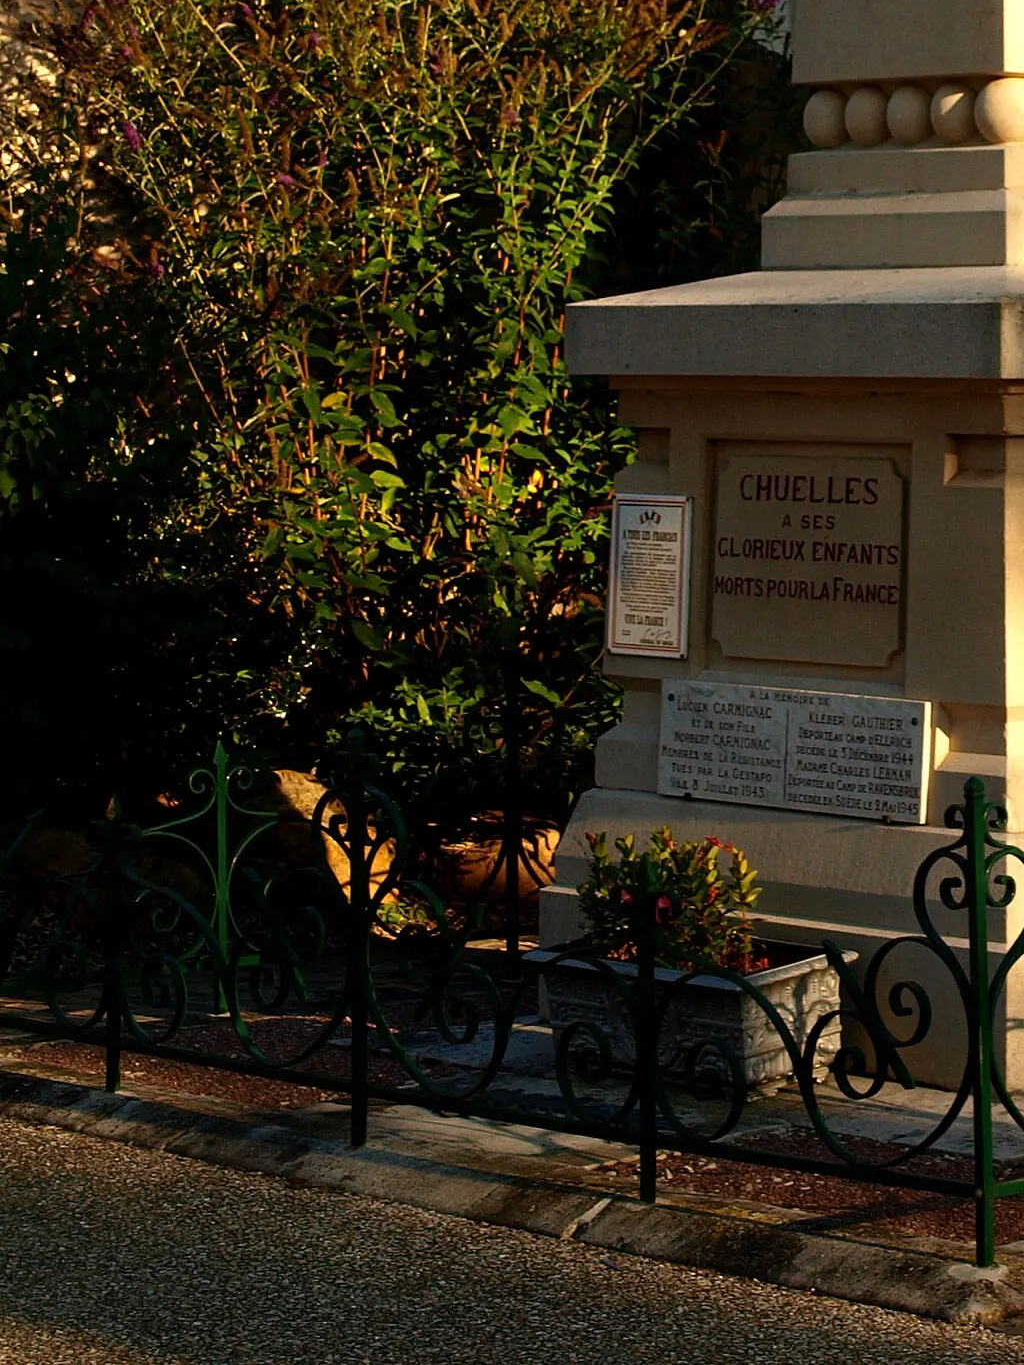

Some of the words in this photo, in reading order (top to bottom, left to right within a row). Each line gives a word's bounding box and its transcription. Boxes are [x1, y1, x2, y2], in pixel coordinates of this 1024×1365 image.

[740, 474, 878, 504] CHUELLES
[781, 514, 792, 528] A
[801, 514, 836, 530] SES
[718, 537, 805, 561] GLORIEUX
[812, 541, 900, 565] ENFANTS
[715, 576, 764, 597] MORTS
[766, 579, 809, 599] POUR
[810, 581, 831, 600] LA
[833, 577, 899, 604] FRANCE
[677, 697, 708, 713] LUCIEN
[713, 702, 772, 719] CARMIGNAC
[852, 714, 902, 731] GAUTHIER
[713, 734, 771, 751] CARMIGNAC
[661, 745, 699, 760] MEMBRES
[703, 751, 713, 761] DE
[891, 751, 913, 766] 1944
[797, 759, 829, 774] MADAME
[732, 767, 772, 783] GESTAPO
[703, 779, 739, 796] JUILLET
[742, 784, 765, 798] 1943
[836, 779, 857, 792] CAMP
[897, 802, 919, 815] 1945
